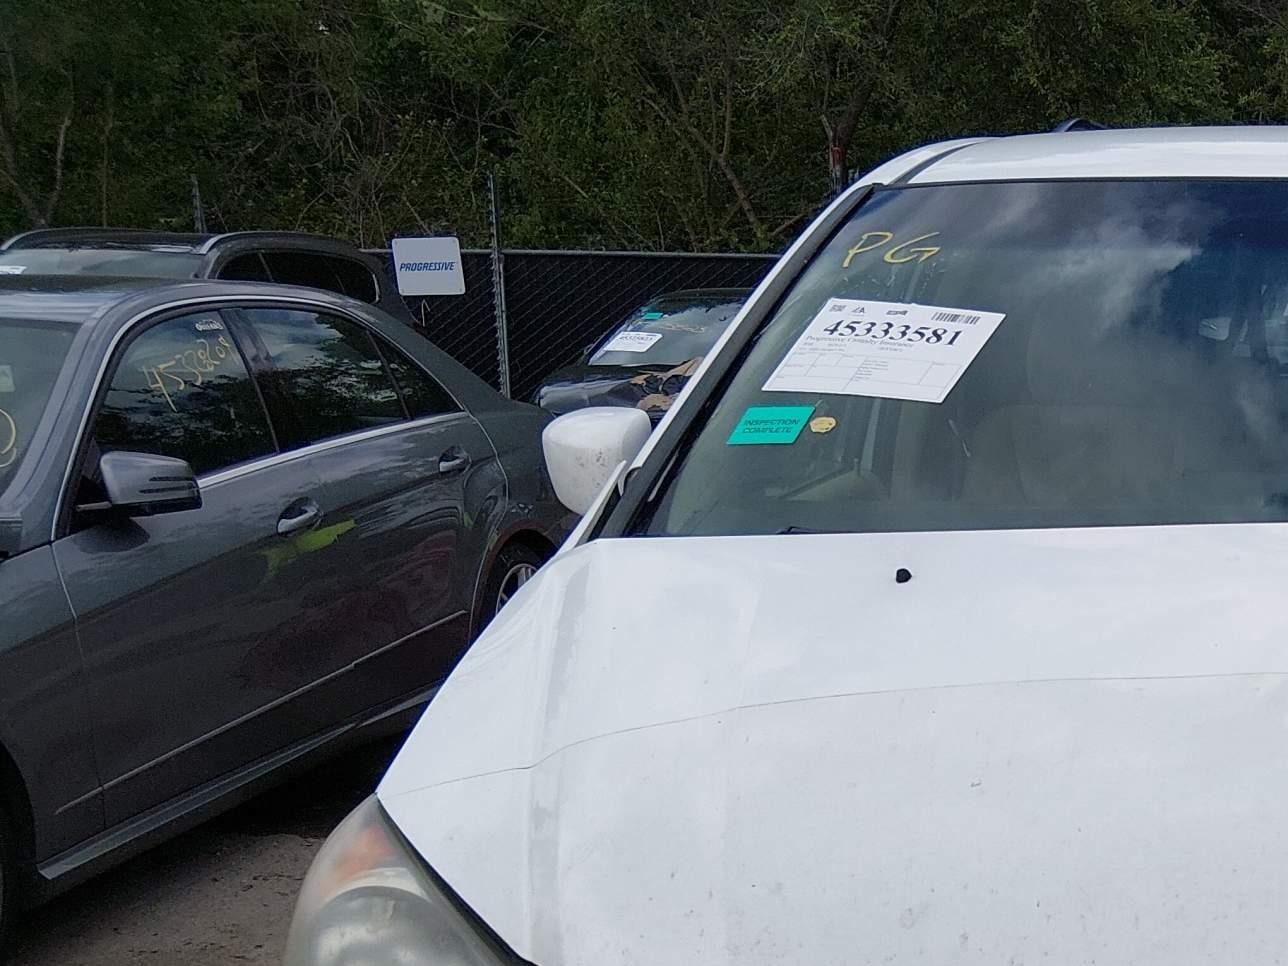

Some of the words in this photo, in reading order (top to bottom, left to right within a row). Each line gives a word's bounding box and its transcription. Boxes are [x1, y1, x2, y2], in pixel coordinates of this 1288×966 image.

[842, 231, 941, 268] PG
[399, 261, 457, 272] PROGRESSIVE
[823, 319, 964, 346] 45333581
[743, 418, 800, 426] INSPECTION
